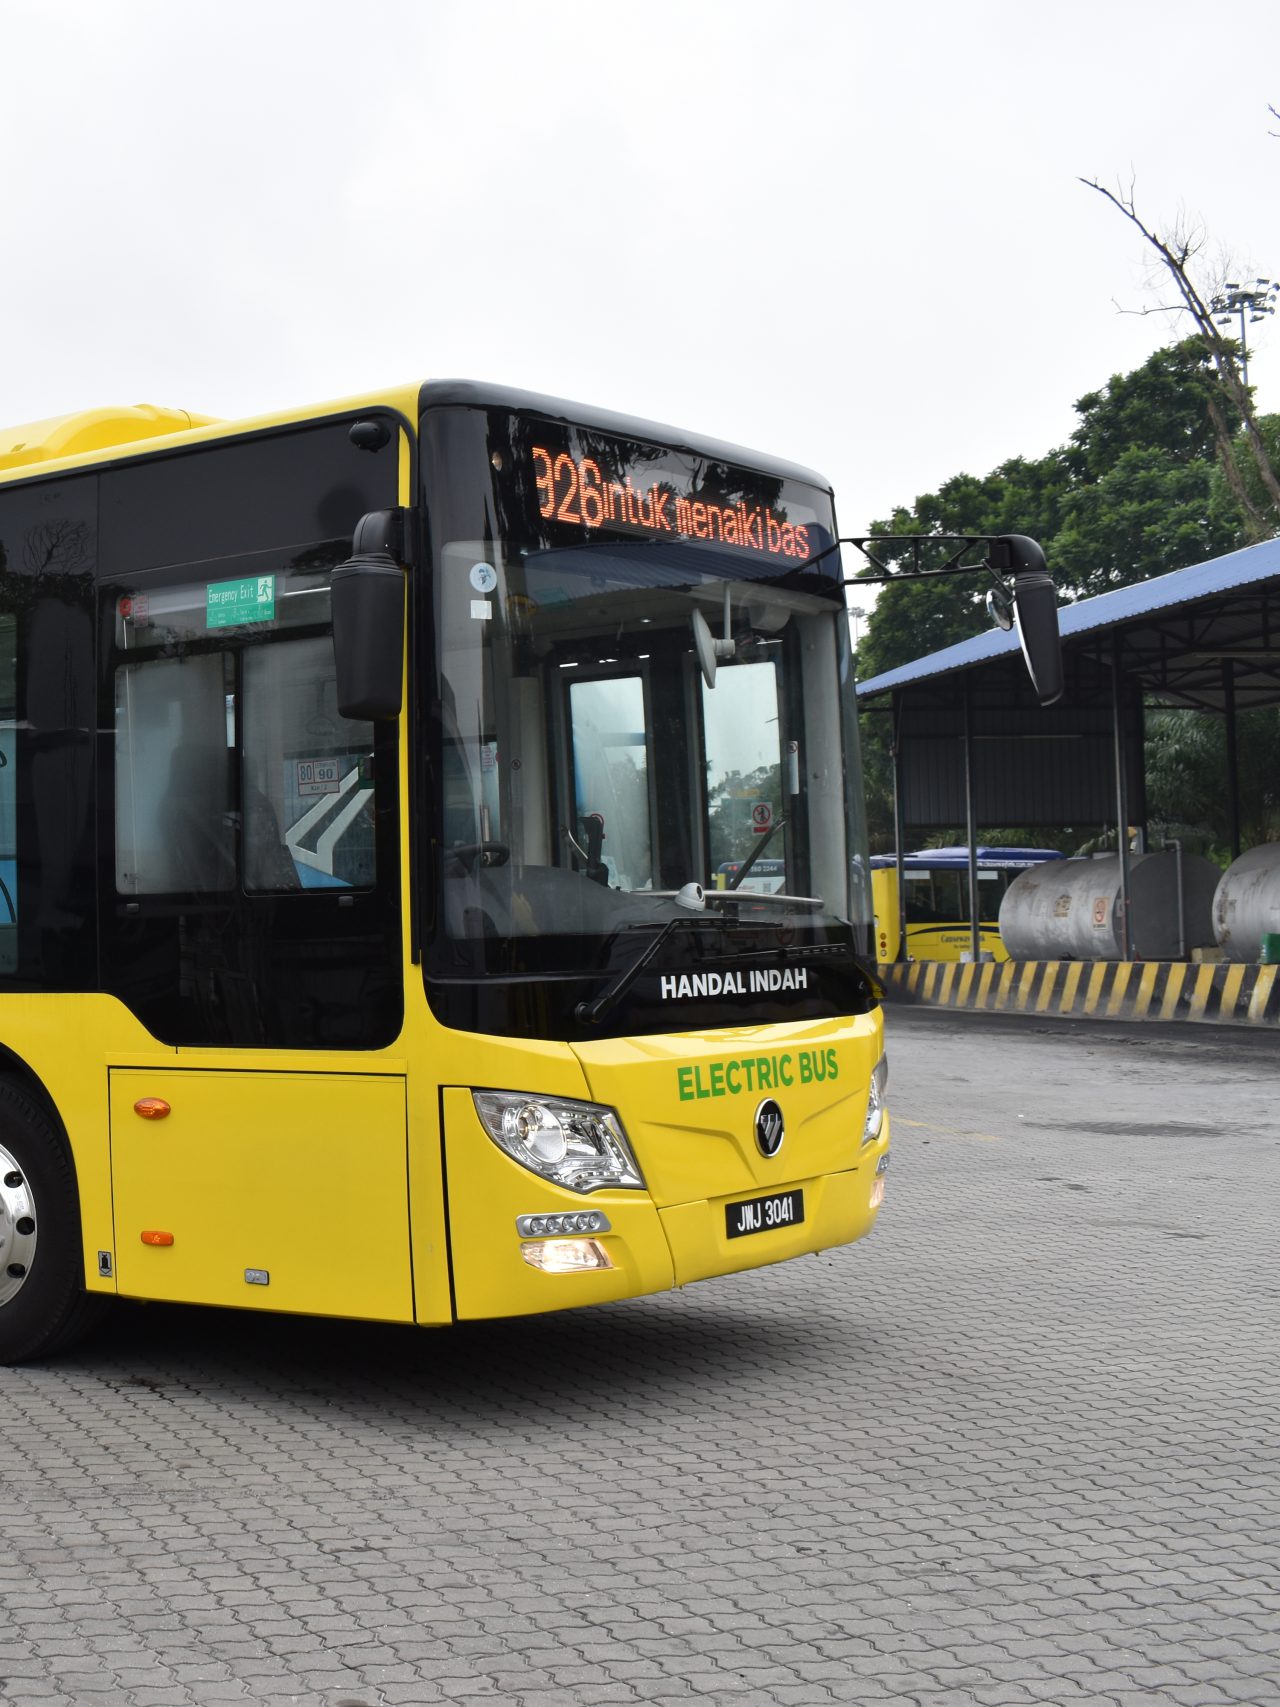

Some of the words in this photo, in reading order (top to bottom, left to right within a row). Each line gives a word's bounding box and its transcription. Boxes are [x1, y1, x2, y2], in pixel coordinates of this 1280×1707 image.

[675, 497, 763, 550] menaiki
[766, 508, 810, 559] bas
[208, 589, 238, 605] Emergency
[240, 584, 254, 600] Exit
[300, 764, 312, 781] 80
[318, 768, 333, 780] 90
[660, 972, 746, 999] HANDAL
[750, 967, 807, 992] INDAH
[677, 1053, 794, 1101] ELECTRIC
[799, 1048, 839, 1084] BUS
[737, 1202, 761, 1232] JWJ
[765, 1196, 793, 1226] 3041
